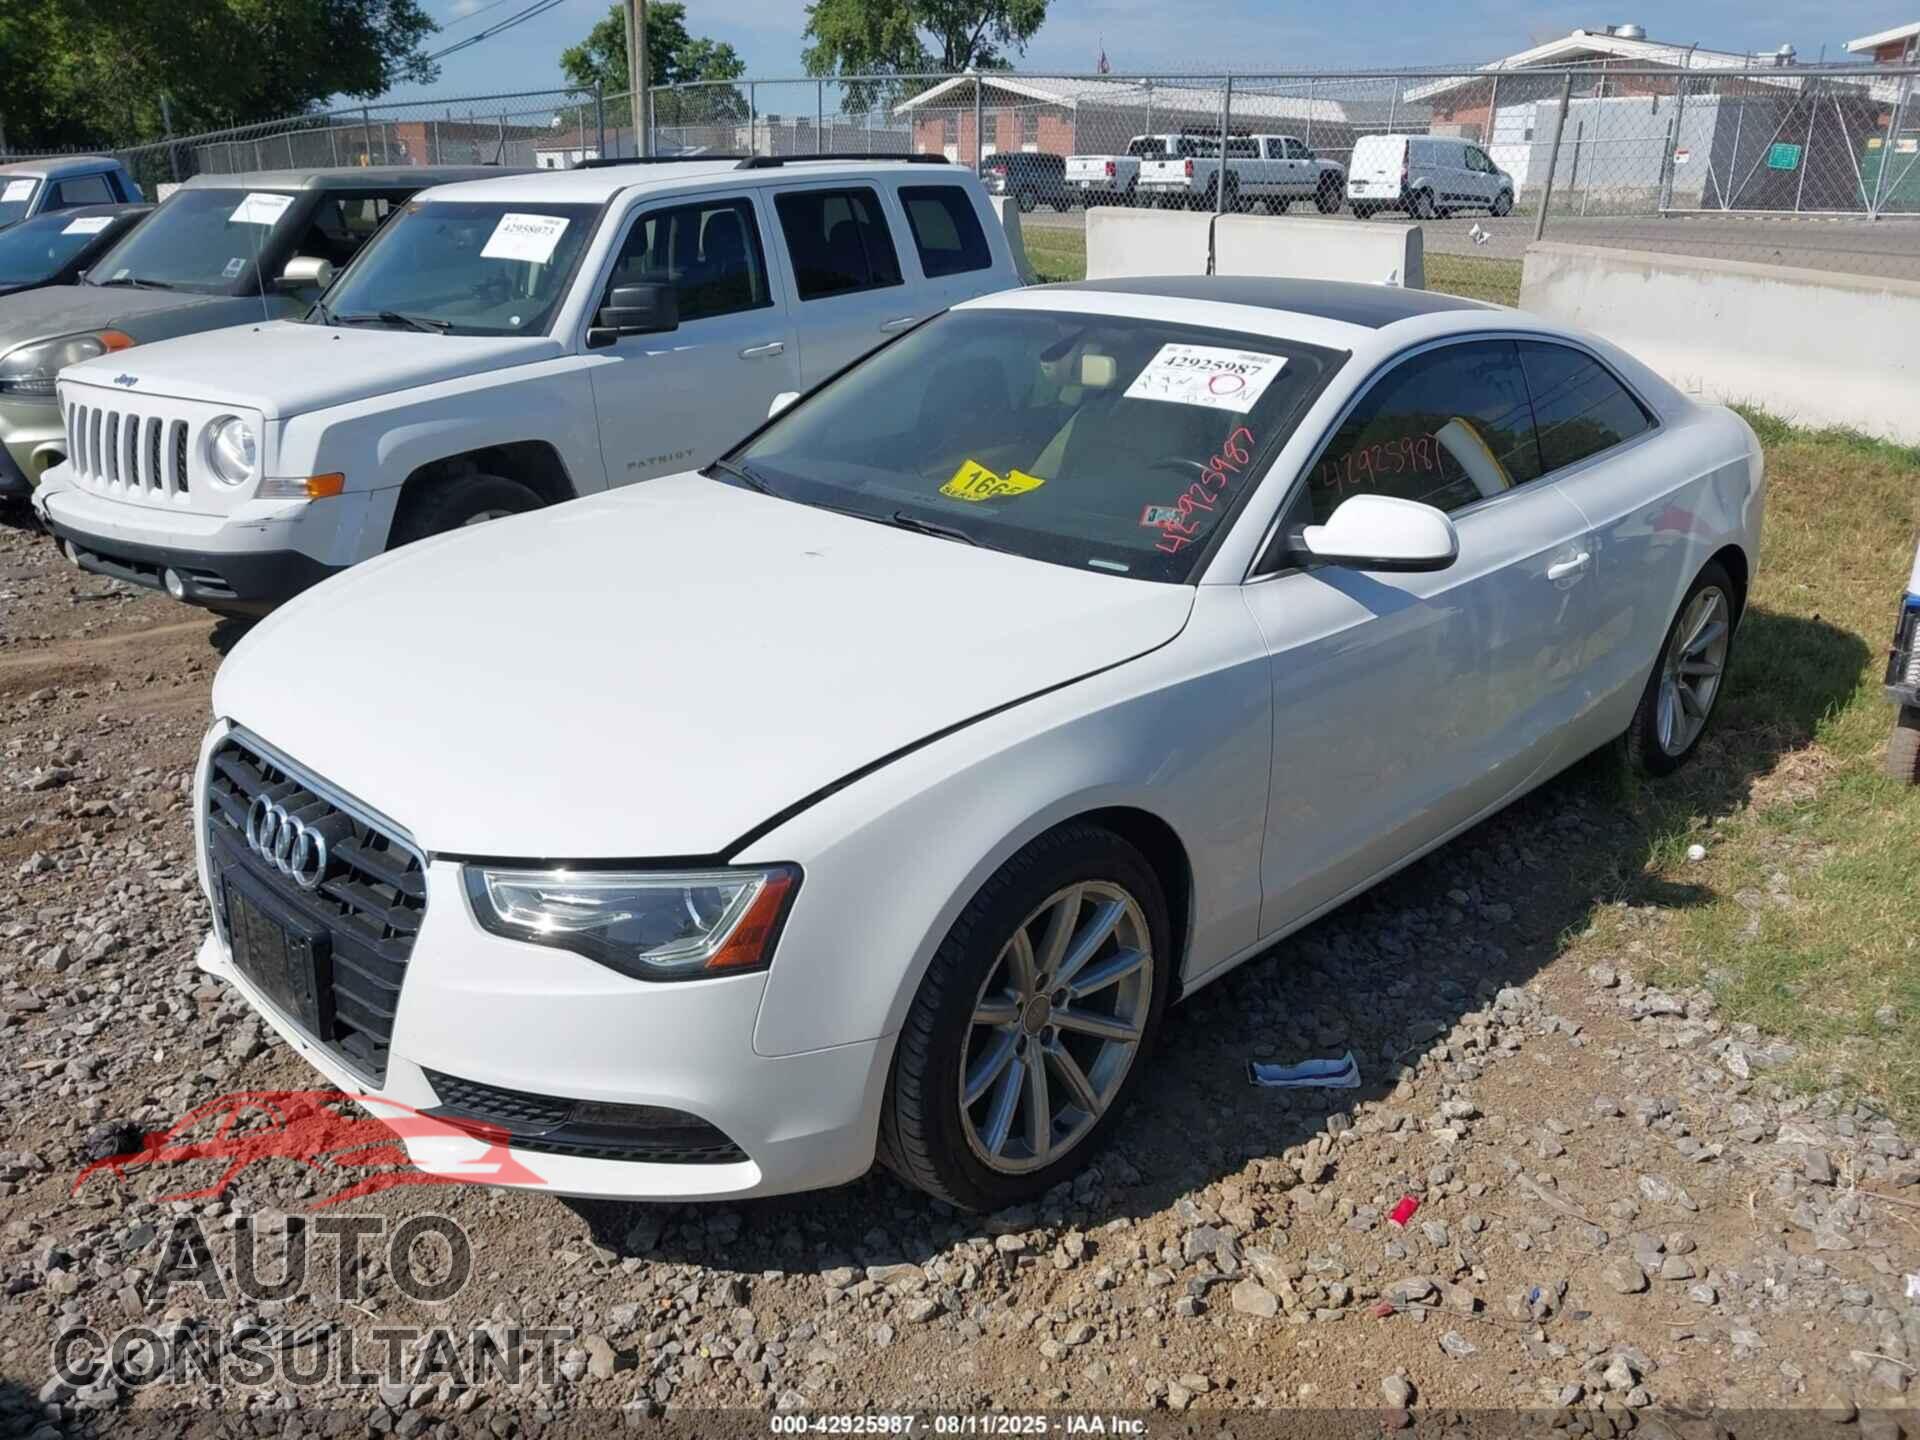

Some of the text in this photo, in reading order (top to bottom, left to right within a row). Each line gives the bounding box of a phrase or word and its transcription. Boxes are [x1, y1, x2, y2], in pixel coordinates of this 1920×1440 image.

[1164, 356, 1262, 376] 42925987
[627, 448, 695, 471] PATRIOT
[1322, 432, 1446, 496] 42925987
[1155, 427, 1255, 553] 42925987
